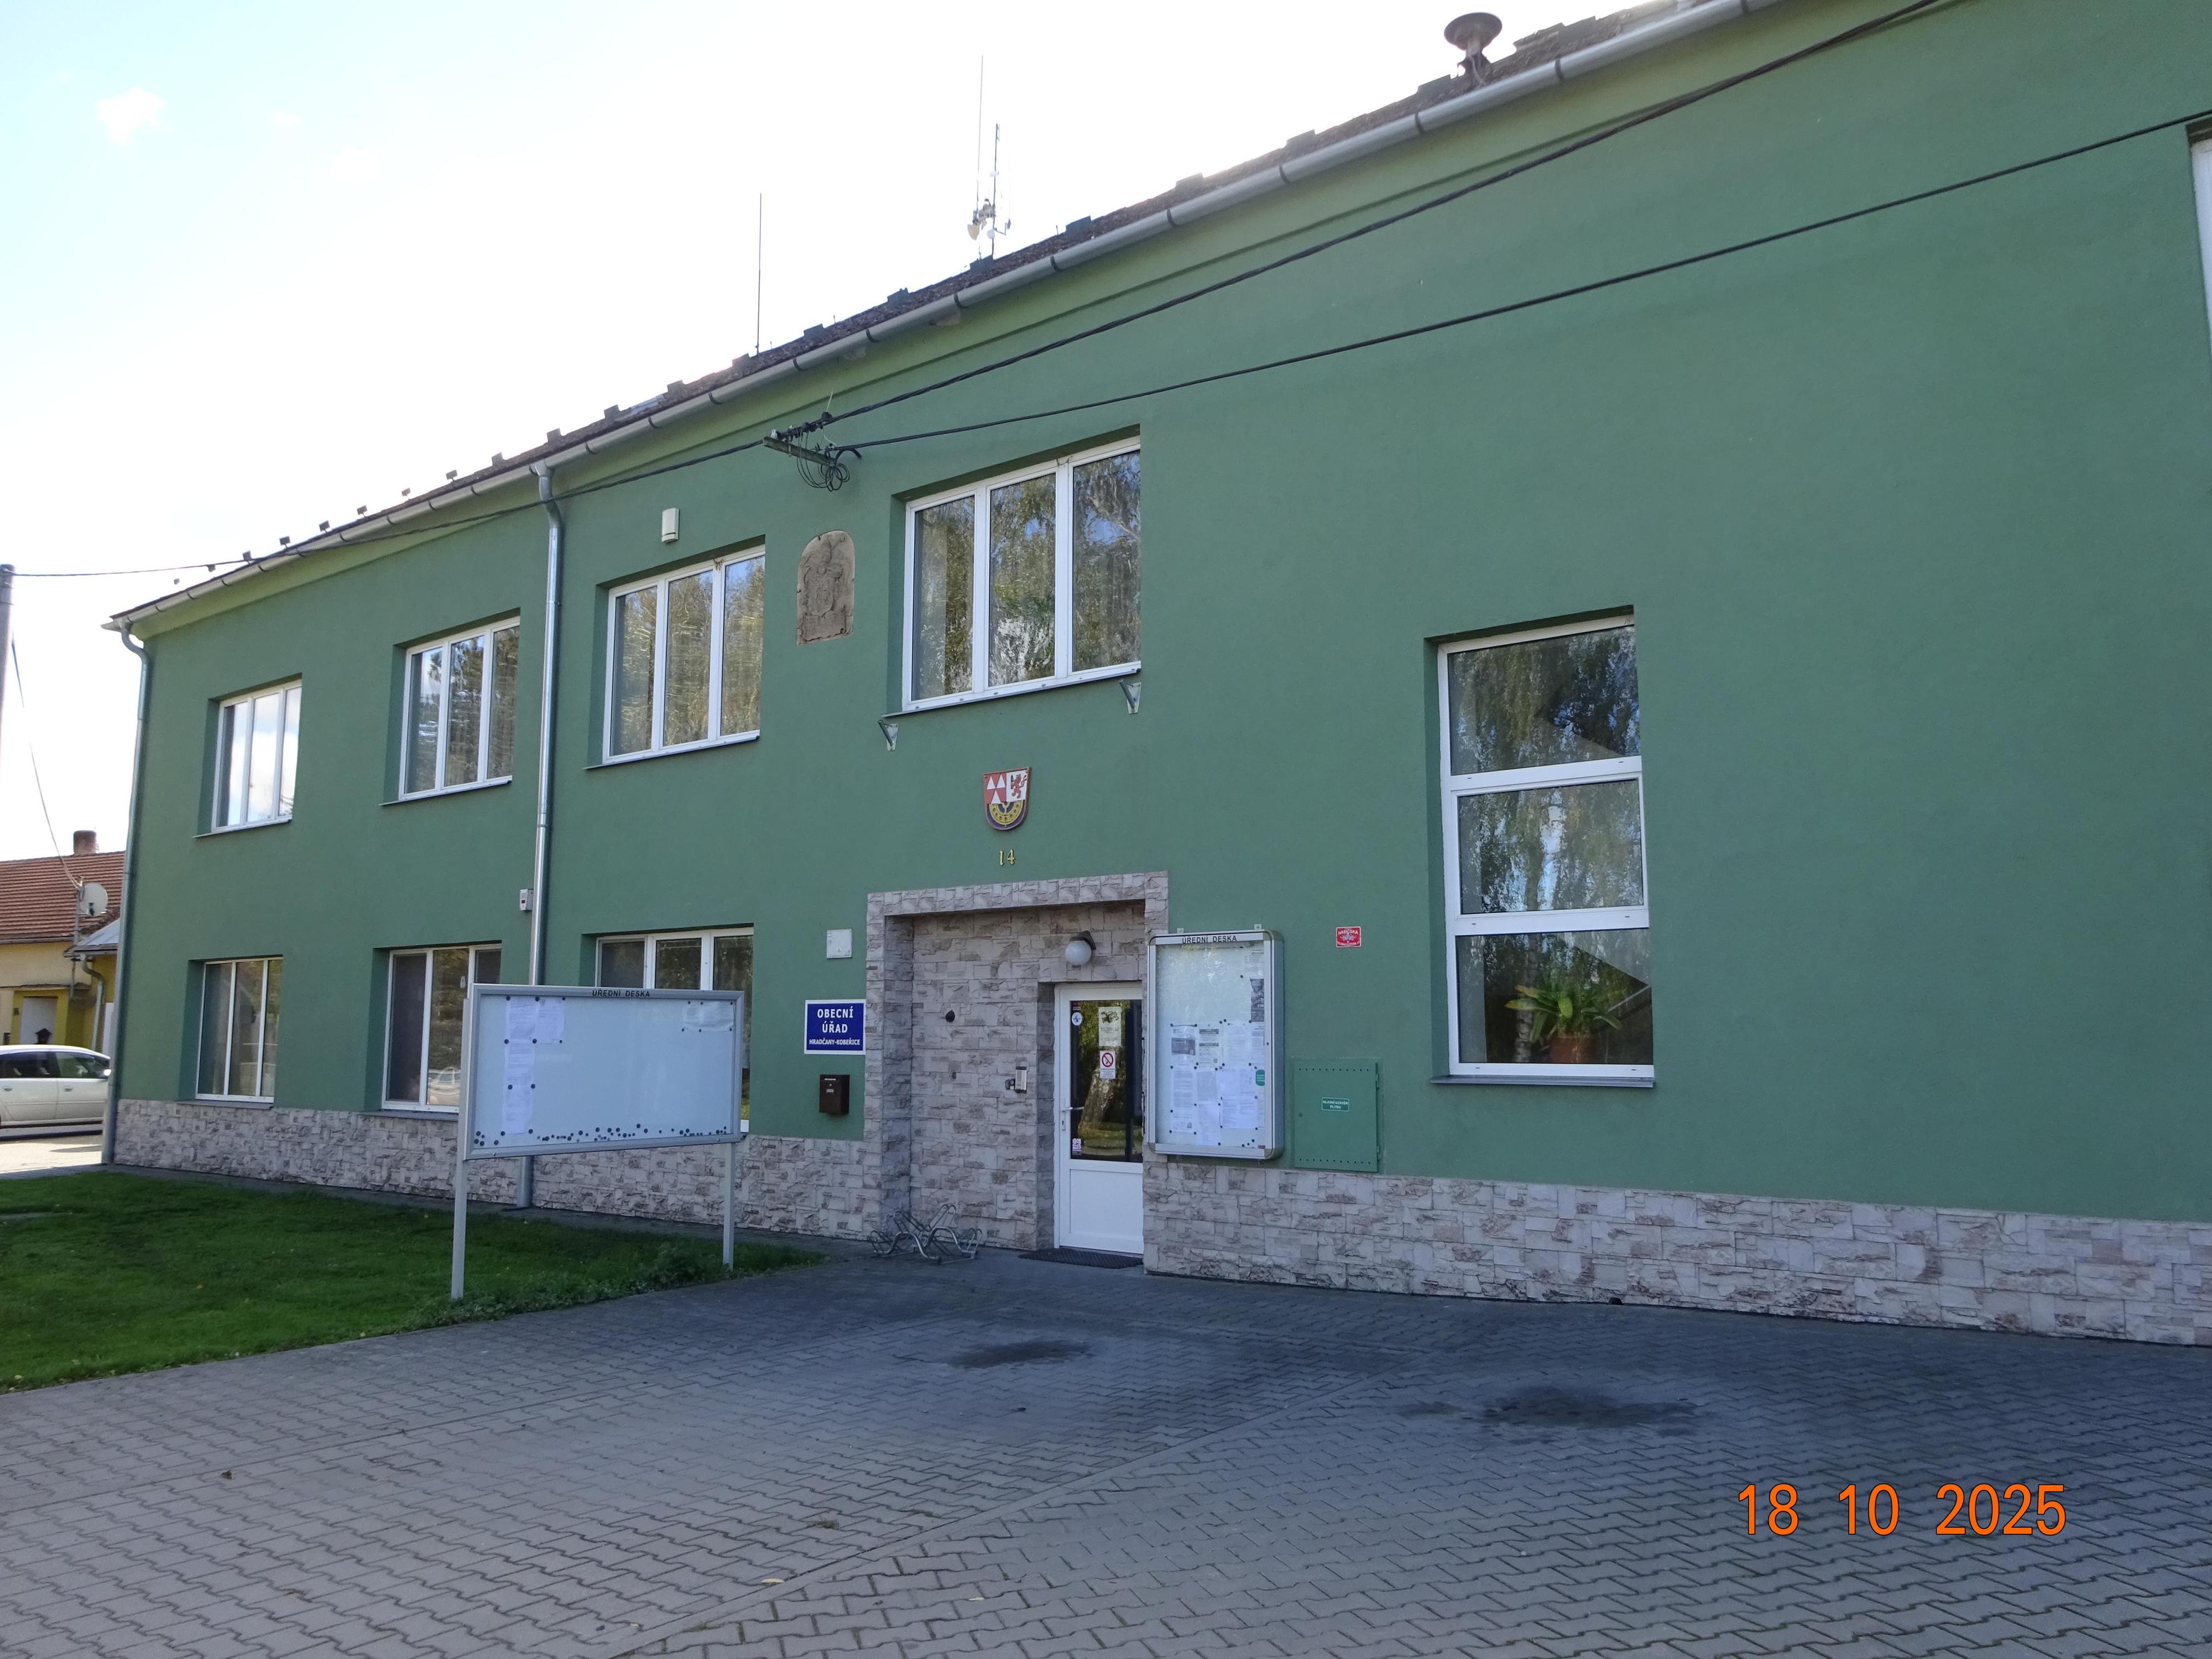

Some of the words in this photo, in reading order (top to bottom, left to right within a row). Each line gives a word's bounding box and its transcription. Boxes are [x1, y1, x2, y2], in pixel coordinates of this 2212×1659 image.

[999, 849, 1015, 866] 14
[817, 1006, 854, 1018] OBECNÍ
[822, 1021, 848, 1033] ÚŘAD
